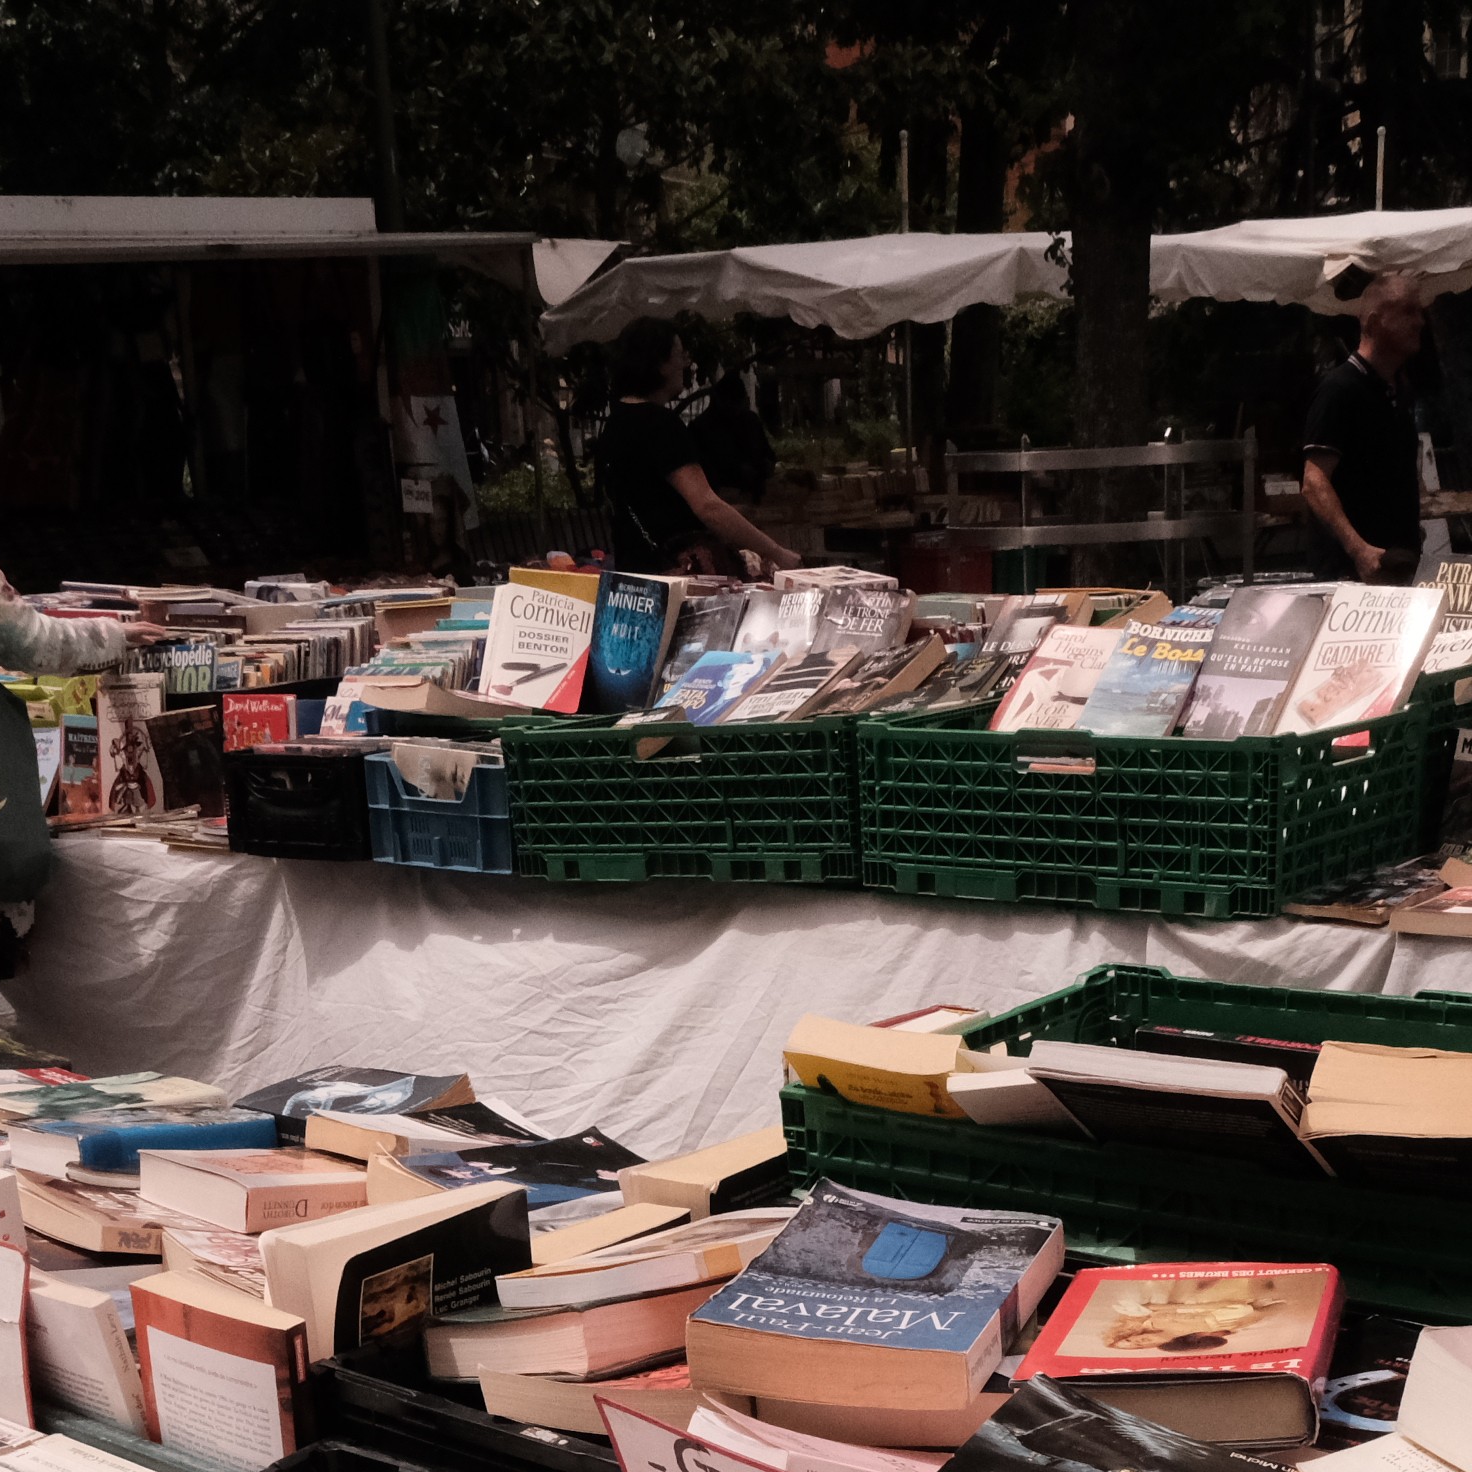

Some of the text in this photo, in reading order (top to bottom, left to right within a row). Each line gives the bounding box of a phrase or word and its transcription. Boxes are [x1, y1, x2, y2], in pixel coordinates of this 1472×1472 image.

[532, 589, 574, 611] Patricia
[608, 592, 654, 613] MINIER
[1358, 591, 1409, 609] Patricia
[510, 595, 591, 634] Cornwell
[518, 631, 569, 644] DOSSIER
[611, 623, 639, 639] NUIT
[1128, 620, 1214, 644] BORNICHE
[518, 642, 568, 655] BENTON
[1053, 641, 1104, 659] Higgins
[1120, 640, 1206, 663] Le Boss
[1233, 643, 1291, 654] KELLERMAN
[1322, 644, 1384, 666] CADAVRE
[1210, 653, 1289, 668] QU'ELLE REPOSE
[1223, 663, 1265, 674] EN PAIX
[435, 1267, 491, 1291] Michel Sabourin
[435, 1280, 490, 1302] Renée Sabourin
[435, 1295, 480, 1314] Luc Granger
[728, 1292, 964, 1332] Malaval
[735, 1314, 902, 1340] Jean-Paul
